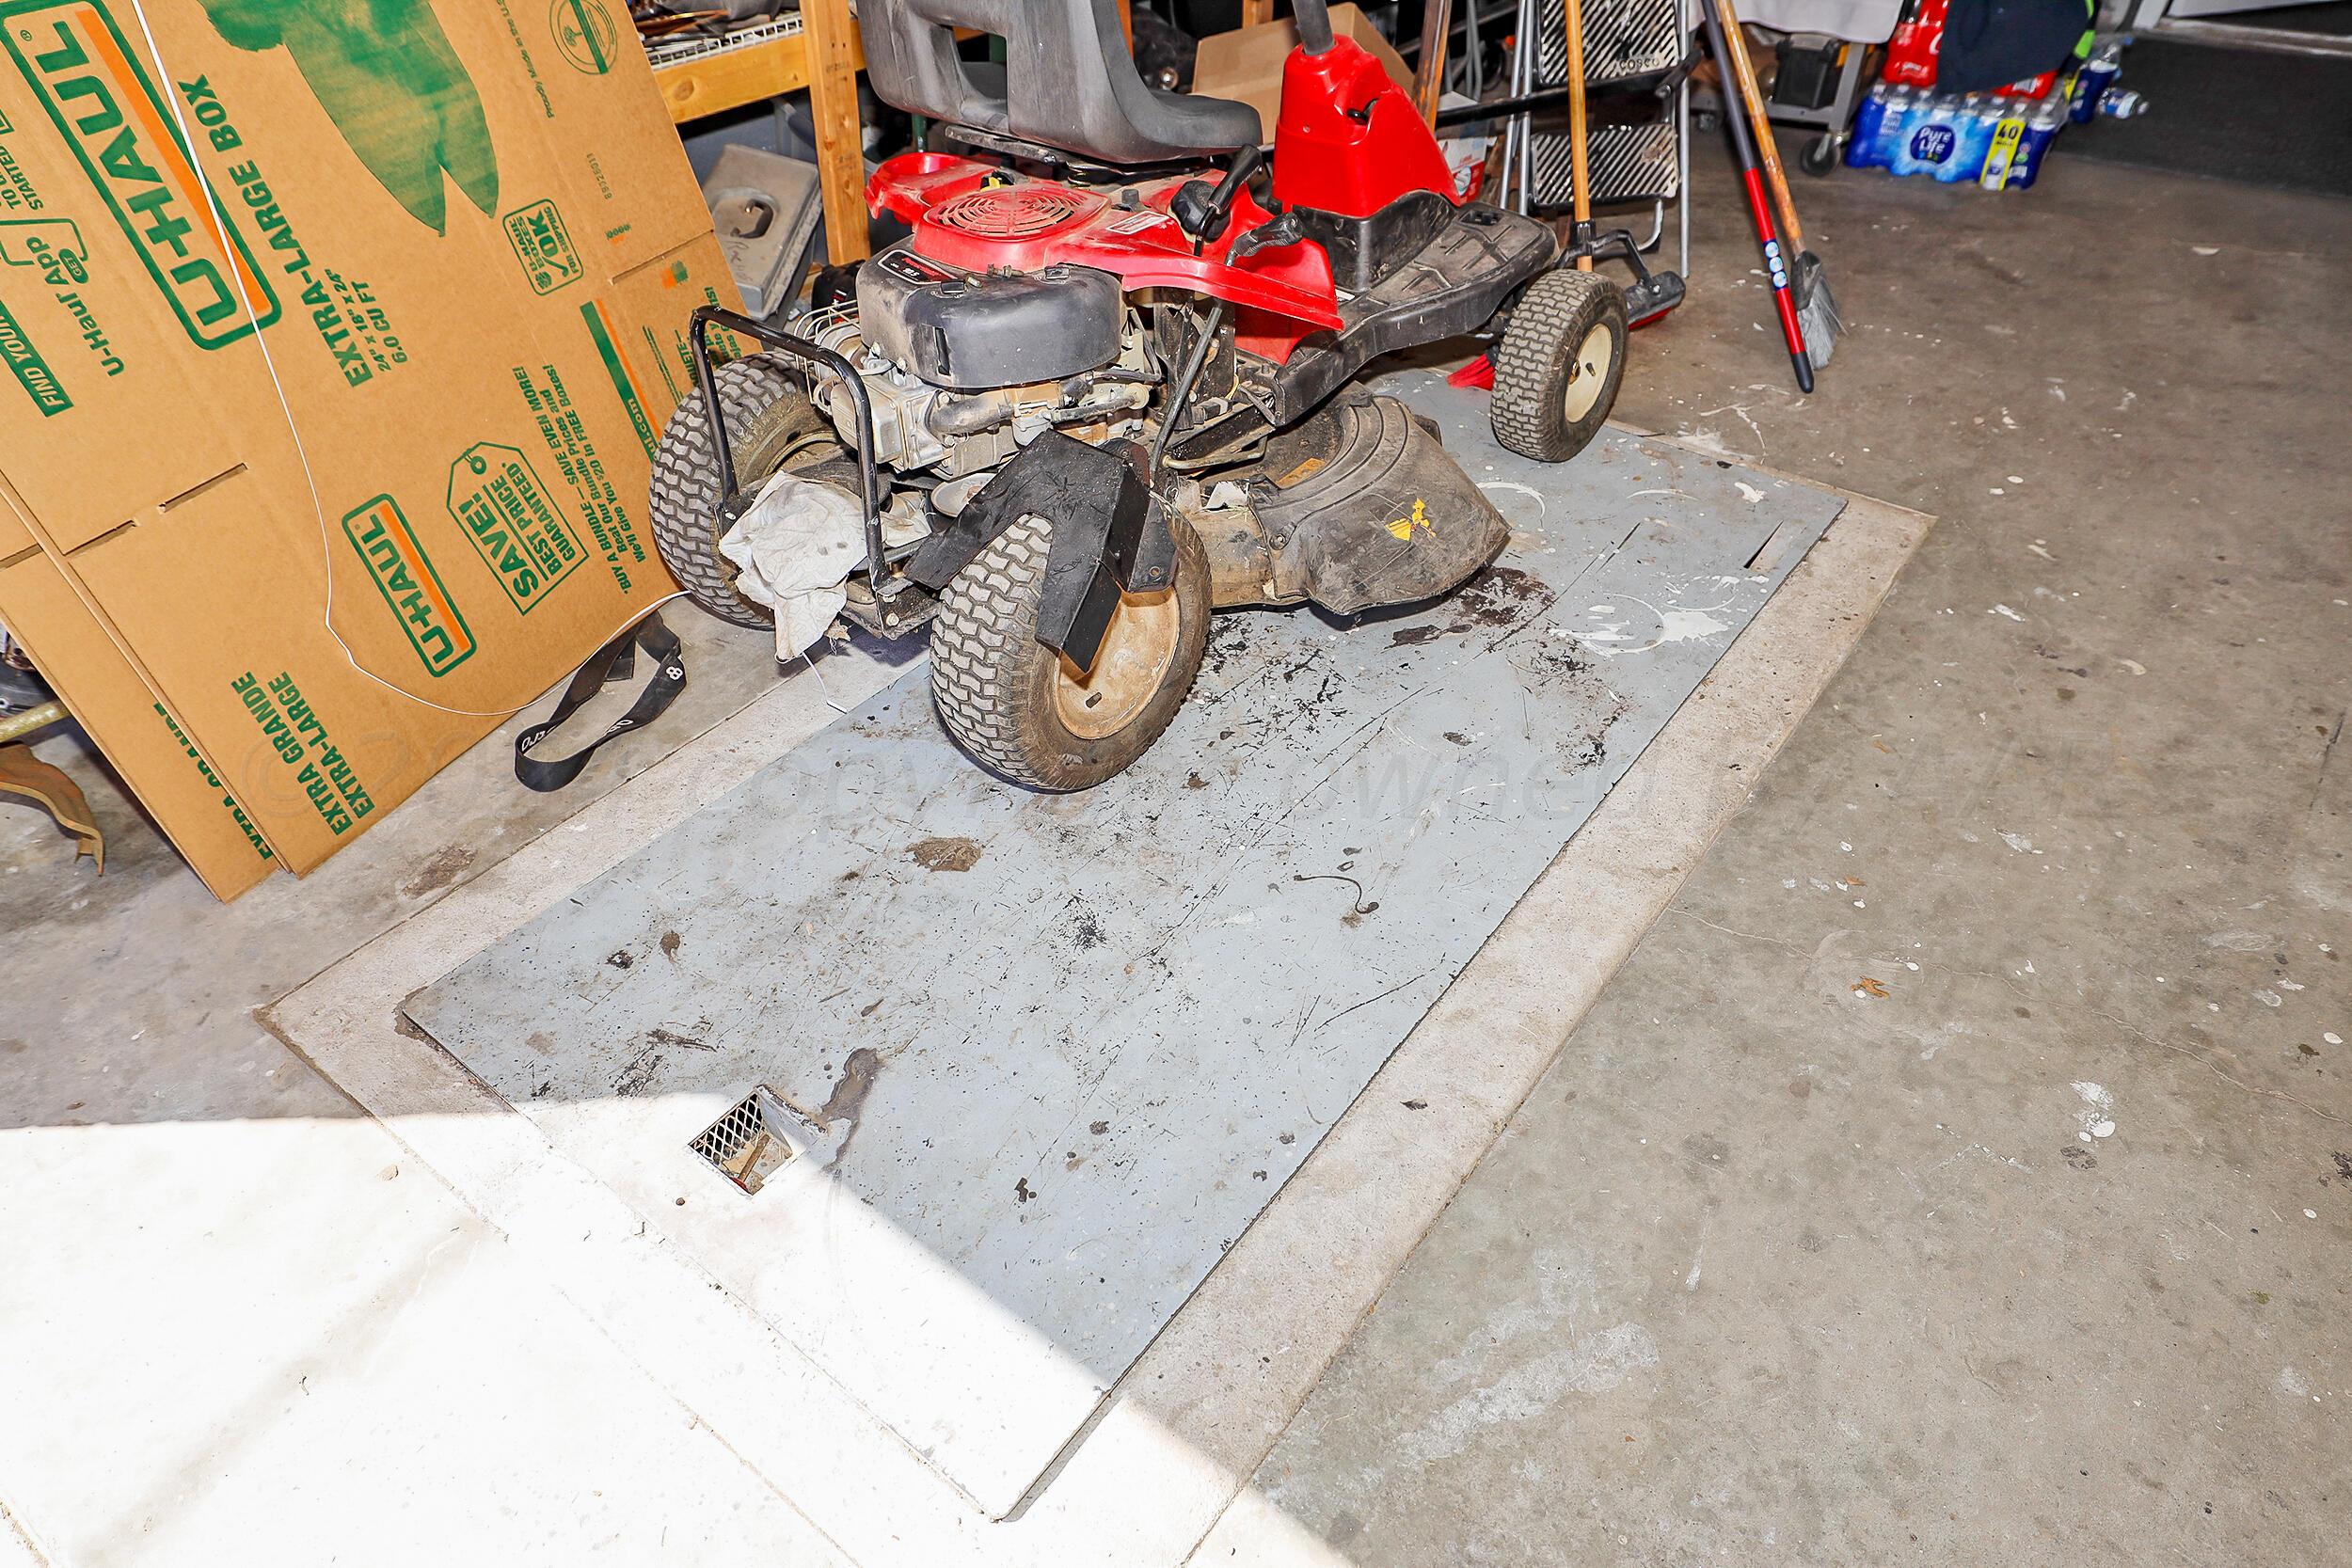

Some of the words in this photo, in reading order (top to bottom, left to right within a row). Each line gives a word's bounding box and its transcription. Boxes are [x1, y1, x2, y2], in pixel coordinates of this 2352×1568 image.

[1618, 56, 1661, 71] COSCO
[178, 74, 243, 152] BOX
[1918, 124, 1952, 144] Pure
[1918, 137, 1947, 154] Life
[1996, 123, 2020, 140] 40
[516, 216, 545, 268] BOXES
[527, 210, 558, 257] OK
[544, 206, 568, 252] SHIPPING
[25, 237, 70, 285] App
[64, 255, 83, 277] GET
[229, 161, 373, 387] EXTRA-LARGE
[565, 254, 579, 274] FOR
[351, 281, 376, 303] FT
[366, 309, 390, 331] CU
[383, 336, 407, 363] 6.0
[24, 368, 65, 407] FIND
[512, 365, 544, 412] MORE!
[538, 388, 561, 414] and
[541, 364, 572, 408] Boxes!
[535, 413, 563, 450] EVEN
[555, 417, 580, 456] Prices
[564, 408, 589, 443] FREE
[583, 443, 596, 458] in
[554, 451, 580, 486] SAVE
[576, 457, 602, 501] Bundle
[589, 458, 605, 481] $20
[490, 474, 533, 531] PRICE
[602, 481, 618, 505] You
[580, 500, 612, 551] BUNDLE
[597, 502, 613, 524] Our
[613, 506, 632, 539] Give
[458, 492, 539, 597] SAVE!
[526, 529, 564, 577] BEST
[606, 551, 619, 562] A
[610, 525, 628, 554] Beat
[626, 533, 647, 563] We'll
[231, 671, 304, 765] GRANDE
[268, 671, 375, 819] EXTRA-LARGE
[296, 765, 353, 835] EXTRA
